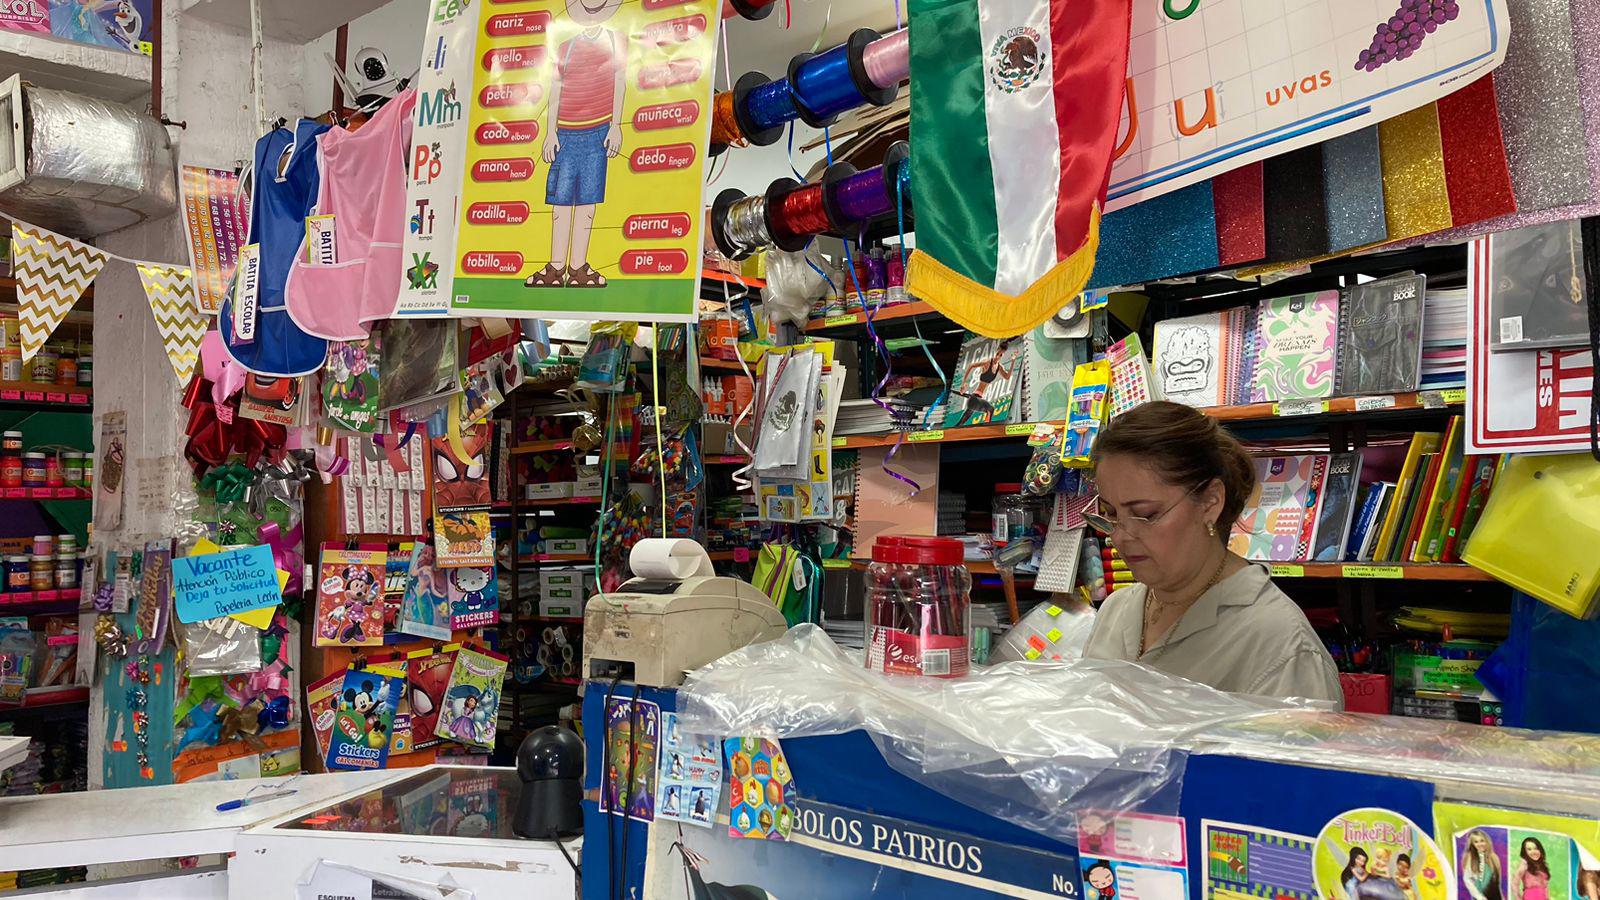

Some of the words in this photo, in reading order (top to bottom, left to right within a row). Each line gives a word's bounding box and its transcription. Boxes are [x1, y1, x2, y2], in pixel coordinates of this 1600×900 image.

[494, 14, 524, 29] nariz
[526, 24, 541, 32] nose
[991, 35, 1008, 57] VIVA
[1007, 27, 1040, 42] MEXICO
[1264, 69, 1333, 108] uvas
[419, 89, 461, 127] Mm
[637, 106, 682, 122] muñeca
[483, 127, 509, 140] codo
[511, 132, 531, 141] elbow
[414, 145, 442, 184] Pp
[637, 149, 666, 165] dedo
[668, 156, 689, 168] finger
[480, 161, 510, 172] mano
[509, 168, 527, 179] hand
[416, 199, 435, 234] Tt
[472, 206, 506, 219] rodilla
[507, 213, 522, 223] knee
[629, 216, 669, 234] pierna
[671, 224, 682, 236] leg
[408, 252, 439, 290] Xx
[467, 254, 500, 268] tobillo
[500, 263, 516, 272] ankle
[635, 251, 653, 269] pie
[657, 262, 672, 272] foot
[246, 257, 257, 290] BATITA
[1393, 291, 1416, 301] BOOK
[242, 295, 254, 335] ESCOLAR
[1330, 466, 1350, 475] BOOK
[186, 551, 257, 577] Vacante
[185, 590, 209, 605] Deja
[214, 586, 227, 595] tu
[229, 575, 277, 593] Solicitud
[455, 610, 494, 624] STICKERS
[348, 728, 363, 742] Go!
[339, 743, 380, 759] Stickers
[791, 806, 863, 846] BOLOS
[872, 823, 983, 874] PATRIOS
[1052, 873, 1079, 896] No.
